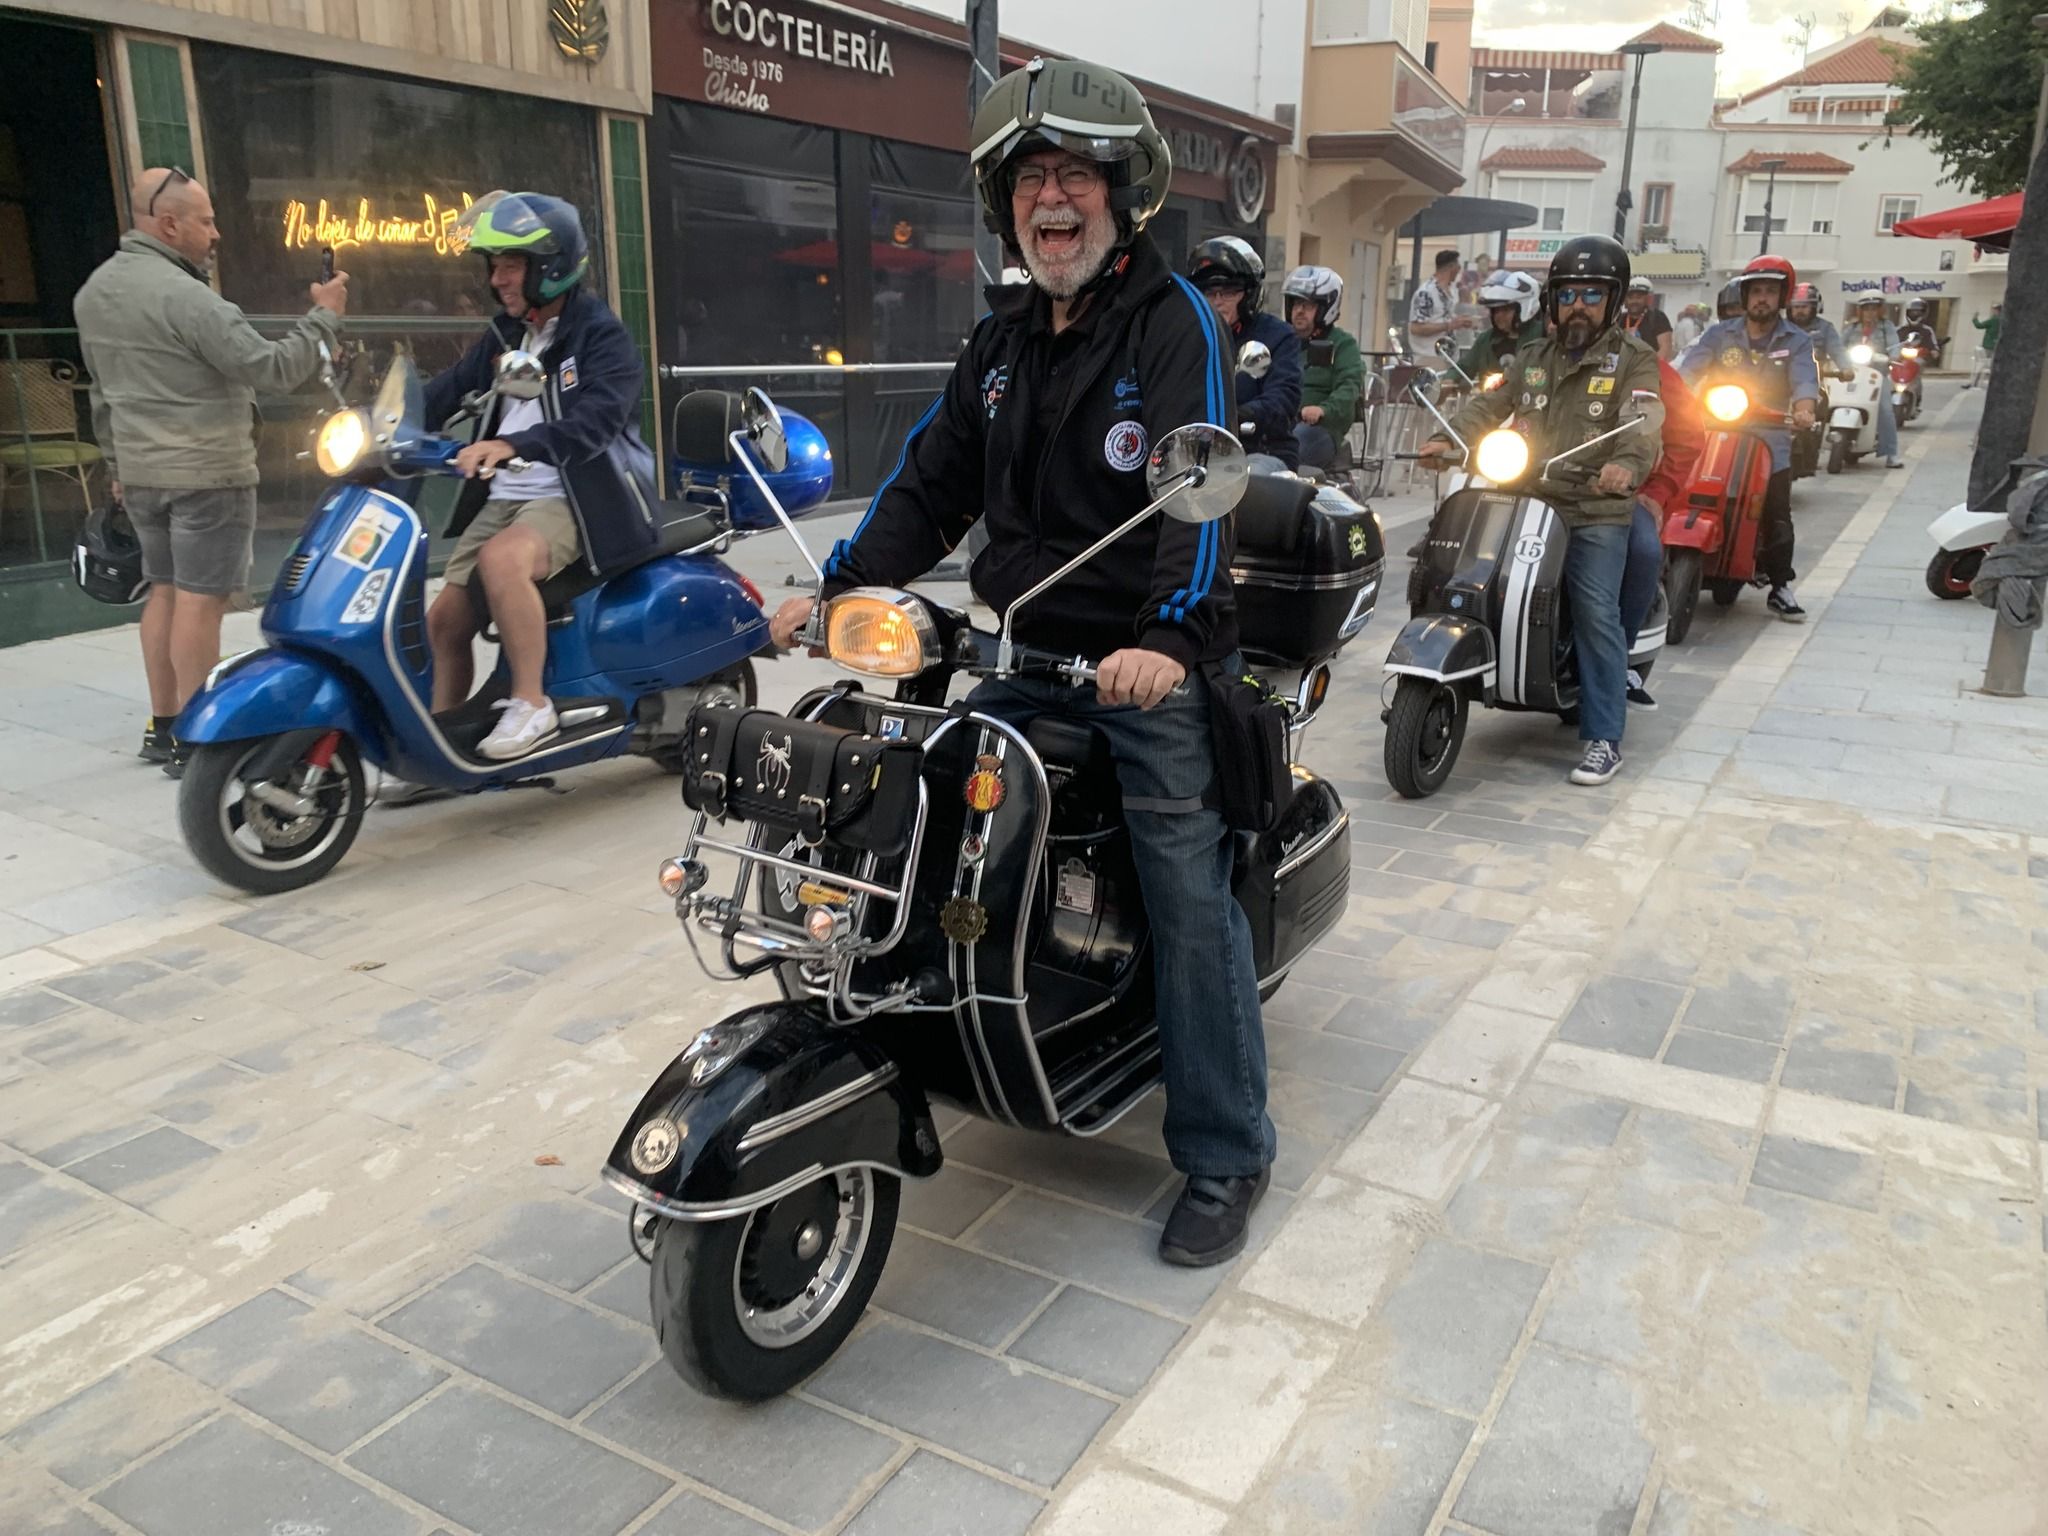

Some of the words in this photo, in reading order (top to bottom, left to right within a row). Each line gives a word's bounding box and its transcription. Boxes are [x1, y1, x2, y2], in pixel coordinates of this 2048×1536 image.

[711, 0, 893, 77] COCTELERÍA
[703, 48, 748, 77] Desde
[751, 59, 783, 84] 1976
[704, 71, 770, 112] Chicho
[284, 200, 313, 248] No
[354, 197, 375, 242] de
[1518, 539, 1543, 558] 15
